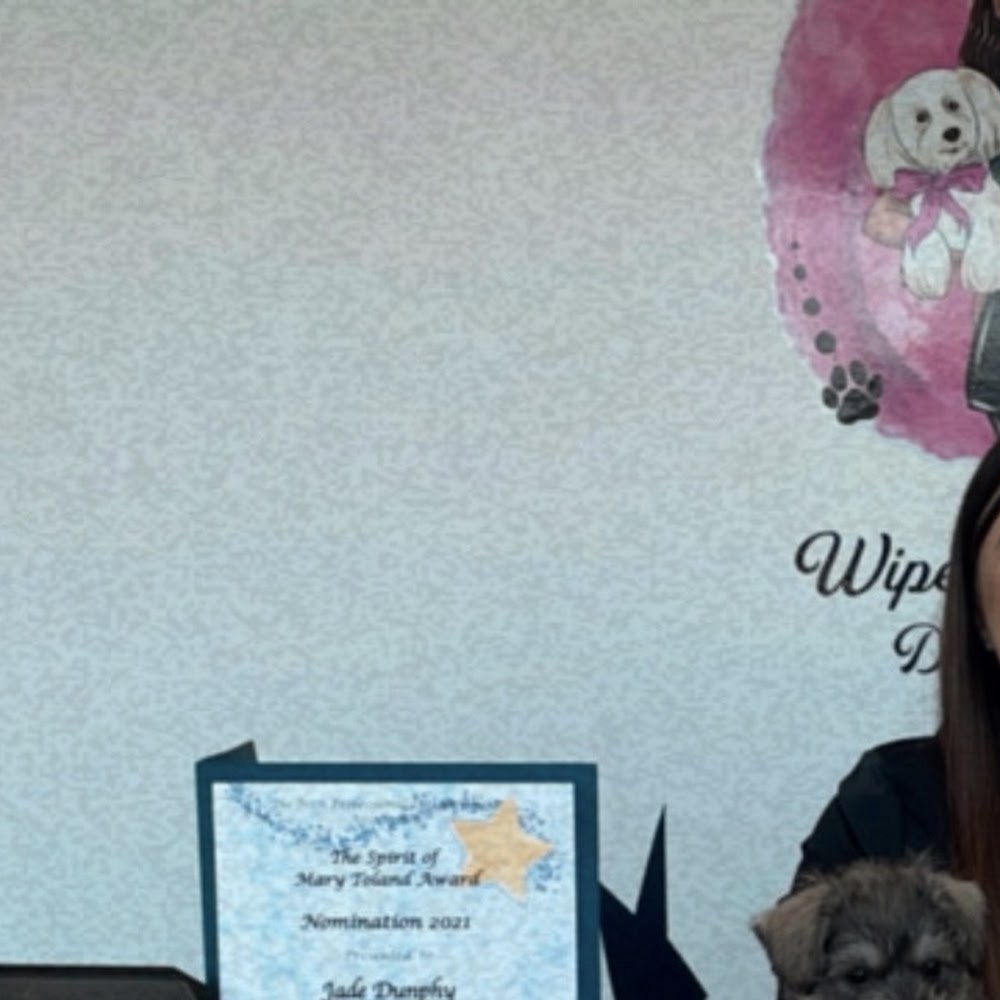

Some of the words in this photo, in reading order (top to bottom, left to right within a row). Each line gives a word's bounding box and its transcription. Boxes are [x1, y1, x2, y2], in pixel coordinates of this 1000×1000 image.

[794, 530, 950, 611] Wipe
[330, 848, 361, 865] The
[366, 849, 416, 869] Spirit
[422, 847, 442, 868] of
[295, 871, 346, 891] Mary
[351, 870, 415, 887] Toland
[416, 869, 484, 887] Award
[301, 913, 423, 930] Nomination
[429, 916, 471, 930] 2021
[321, 976, 367, 1000] Jade
